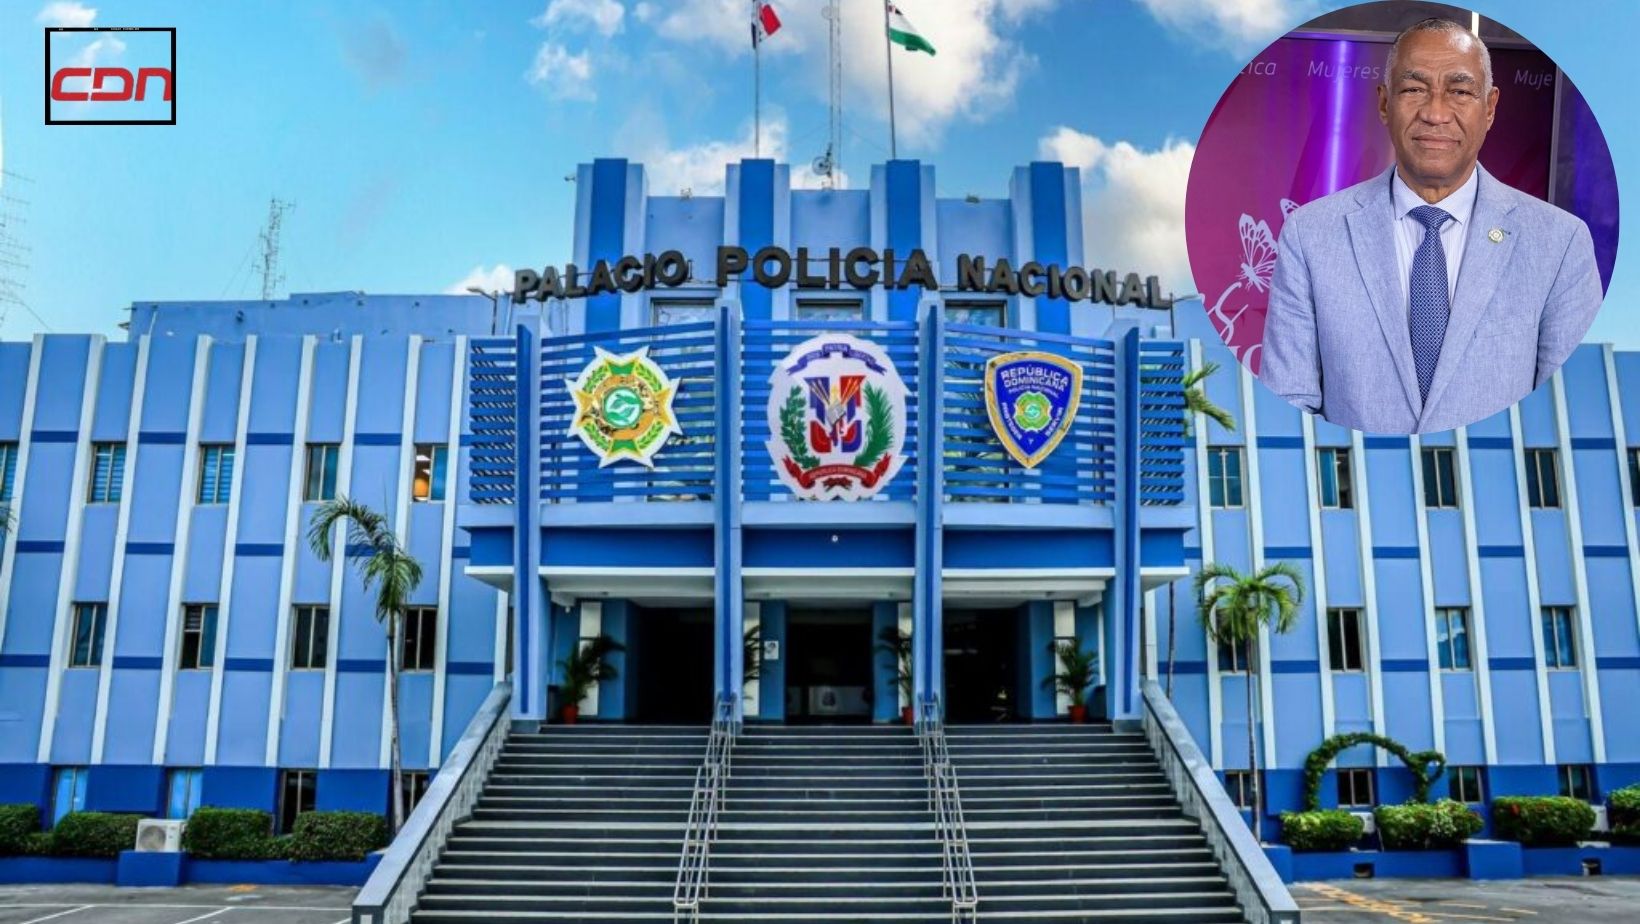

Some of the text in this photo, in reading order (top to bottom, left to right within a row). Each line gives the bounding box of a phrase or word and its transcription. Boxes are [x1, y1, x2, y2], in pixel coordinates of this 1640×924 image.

[1241, 61, 1277, 76] ica
[1307, 60, 1380, 83] Mujeres
[1513, 69, 1553, 90] Muje
[513, 245, 1173, 311] PALACIO POLICIA NACIONAL
